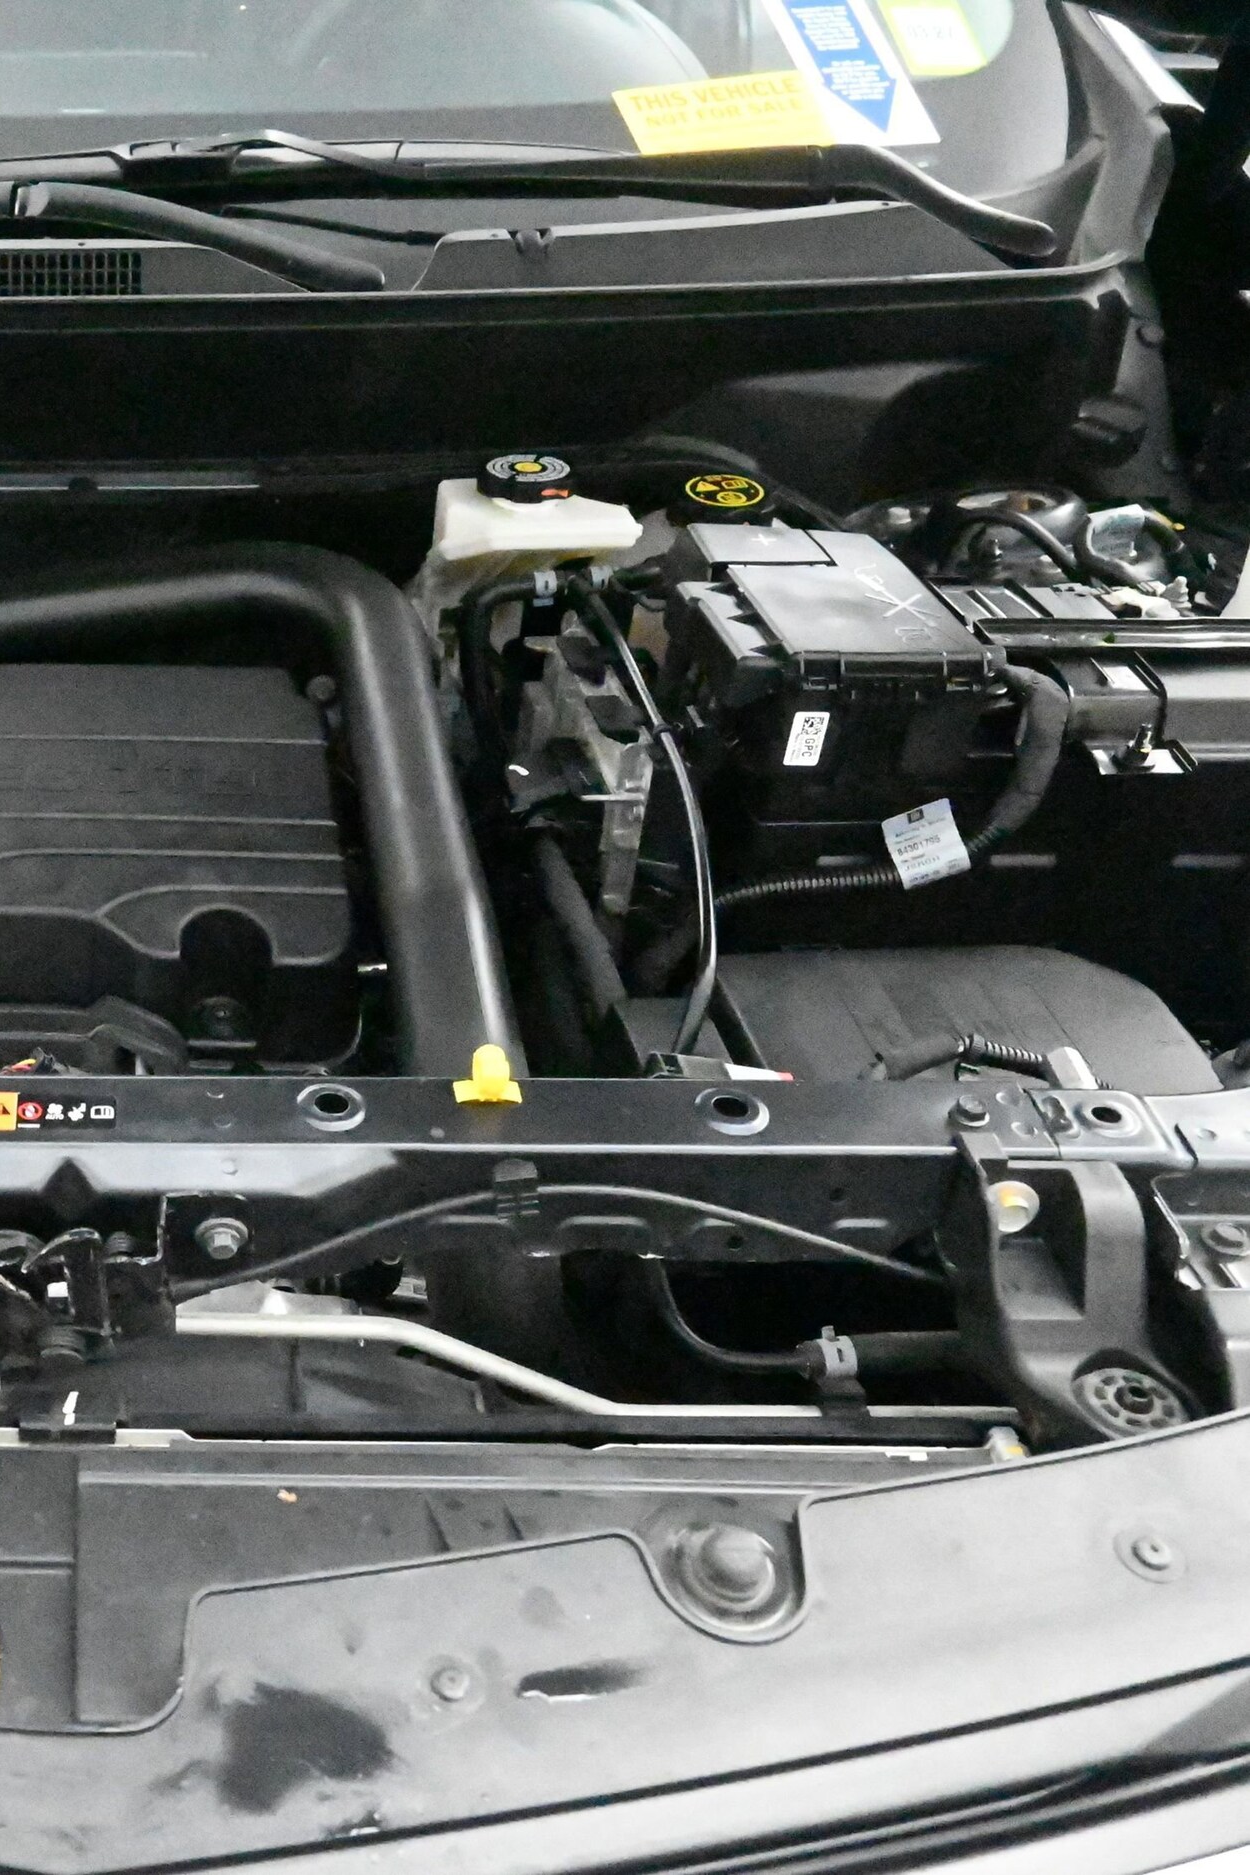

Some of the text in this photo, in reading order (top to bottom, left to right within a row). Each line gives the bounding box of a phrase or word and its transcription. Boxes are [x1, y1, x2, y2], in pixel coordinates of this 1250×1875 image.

[629, 90, 688, 112] THIS
[692, 78, 800, 103] VEHICLE
[646, 98, 802, 126] NOT FOR SALE
[801, 738, 816, 757] GPC
